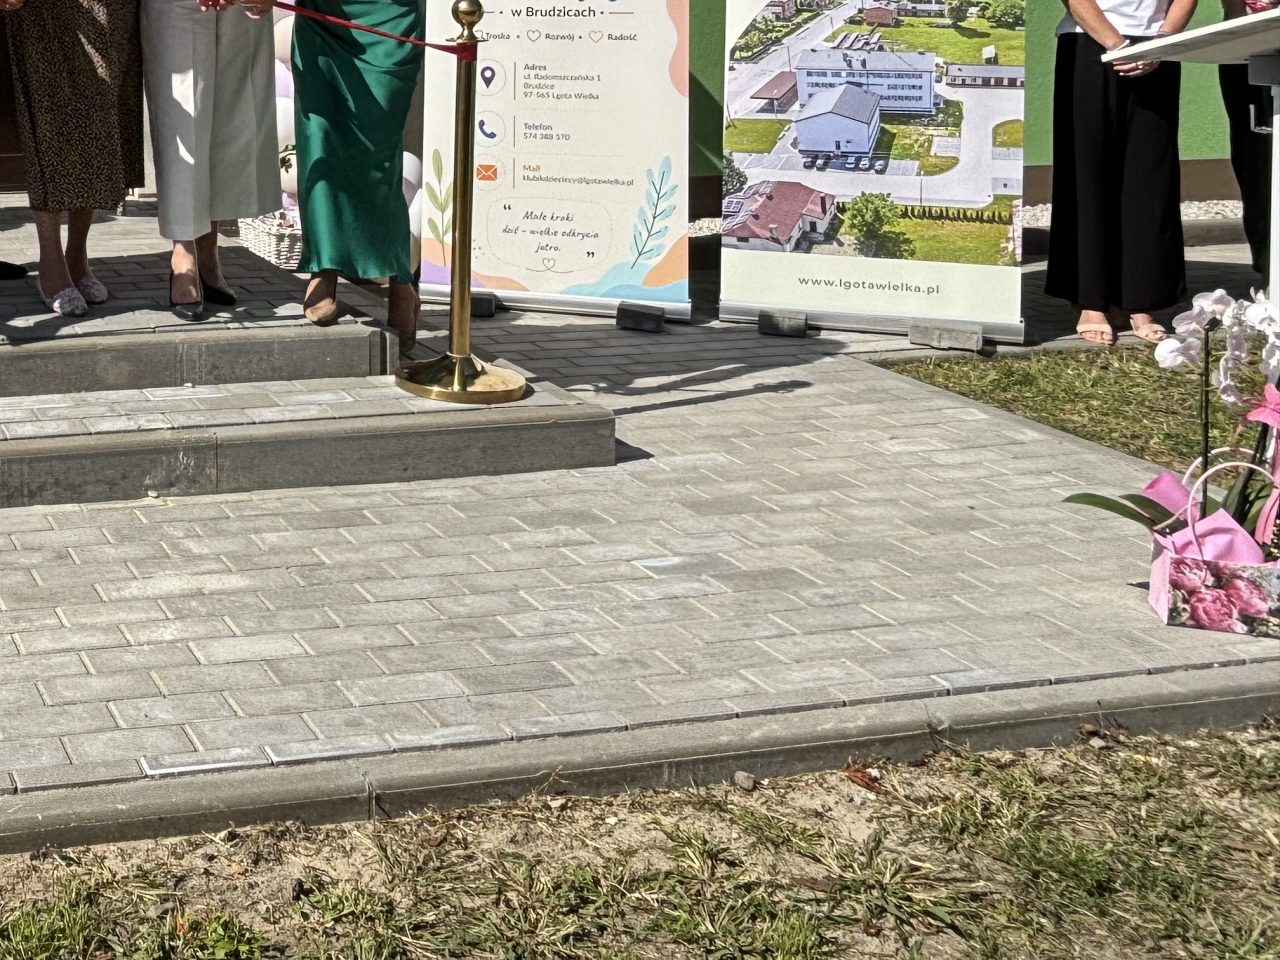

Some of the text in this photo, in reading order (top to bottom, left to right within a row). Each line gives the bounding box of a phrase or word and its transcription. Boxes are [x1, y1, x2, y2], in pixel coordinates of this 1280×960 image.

[511, 6, 596, 18] w Brudzicach
[798, 276, 940, 296] www.lgotawielka.pl
